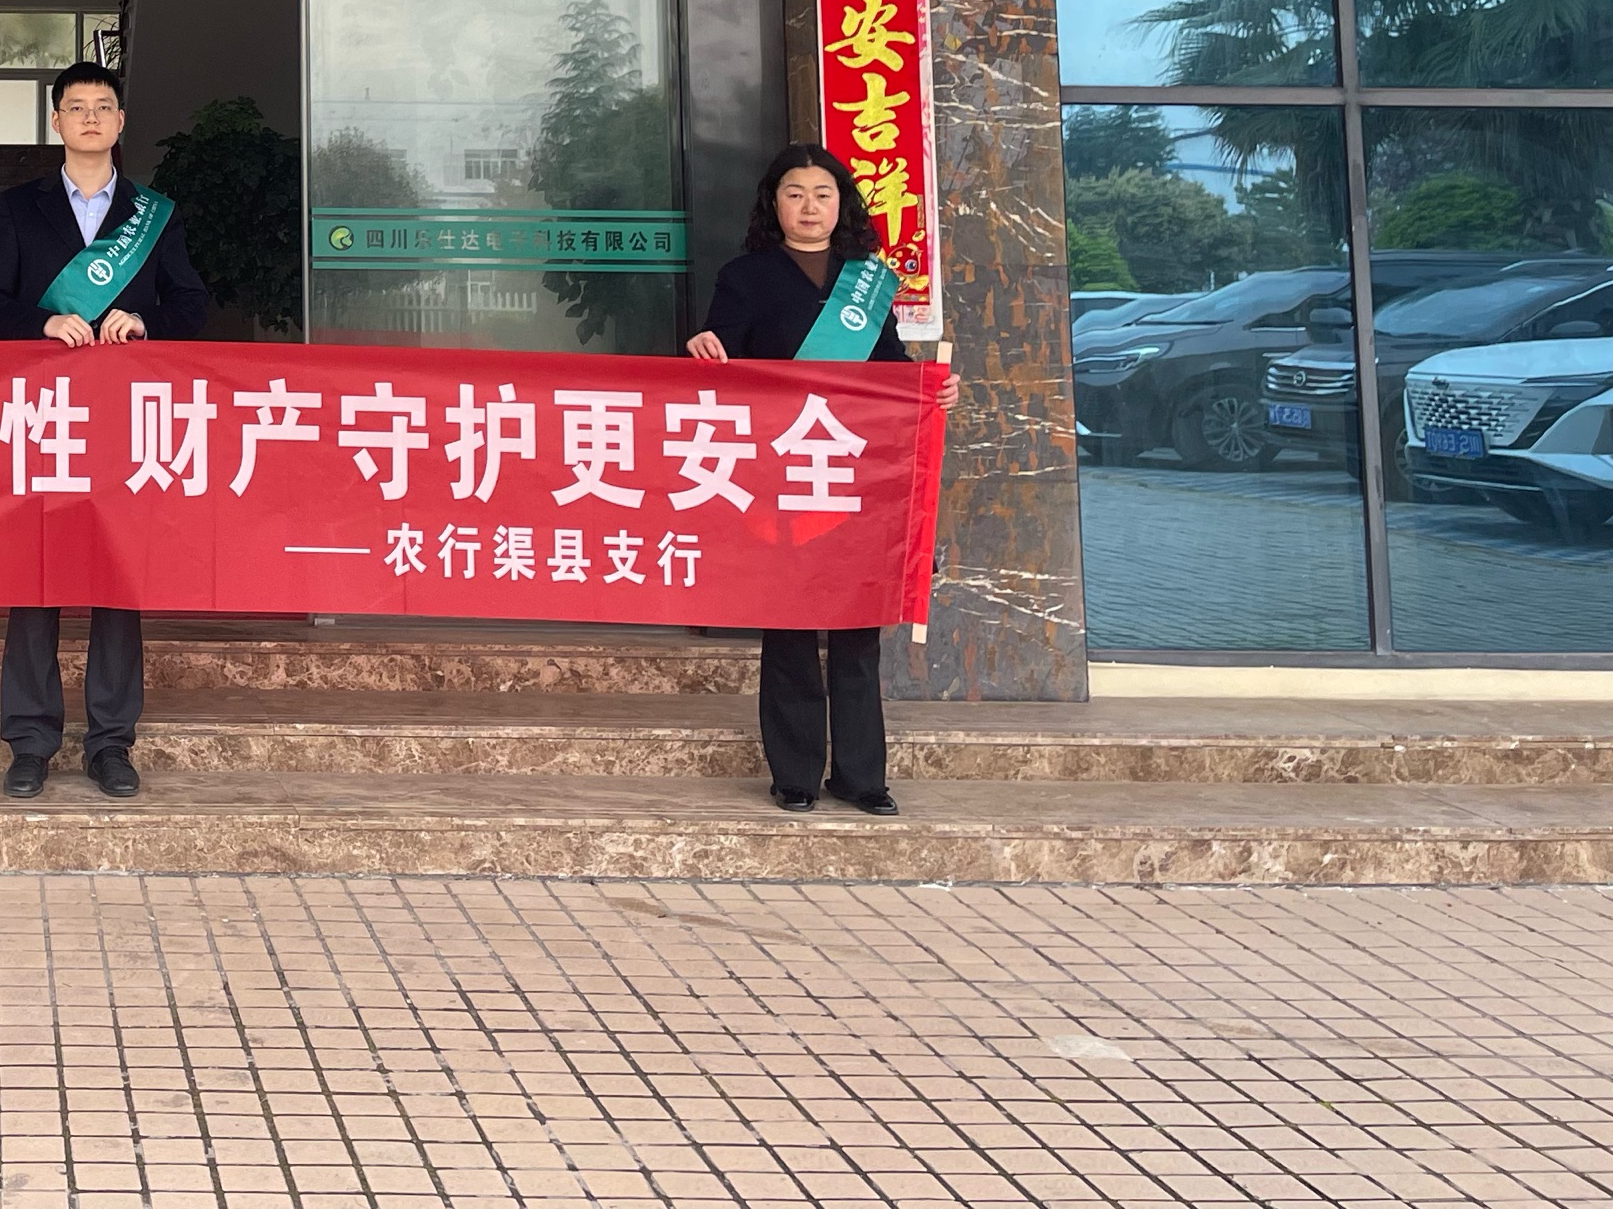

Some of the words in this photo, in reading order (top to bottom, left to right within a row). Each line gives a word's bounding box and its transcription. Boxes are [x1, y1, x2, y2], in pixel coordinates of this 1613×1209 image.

[366, 228, 671, 252] 四川乐仕达电子科技有限公司
[125, 378, 869, 513] 财产守护更安全
